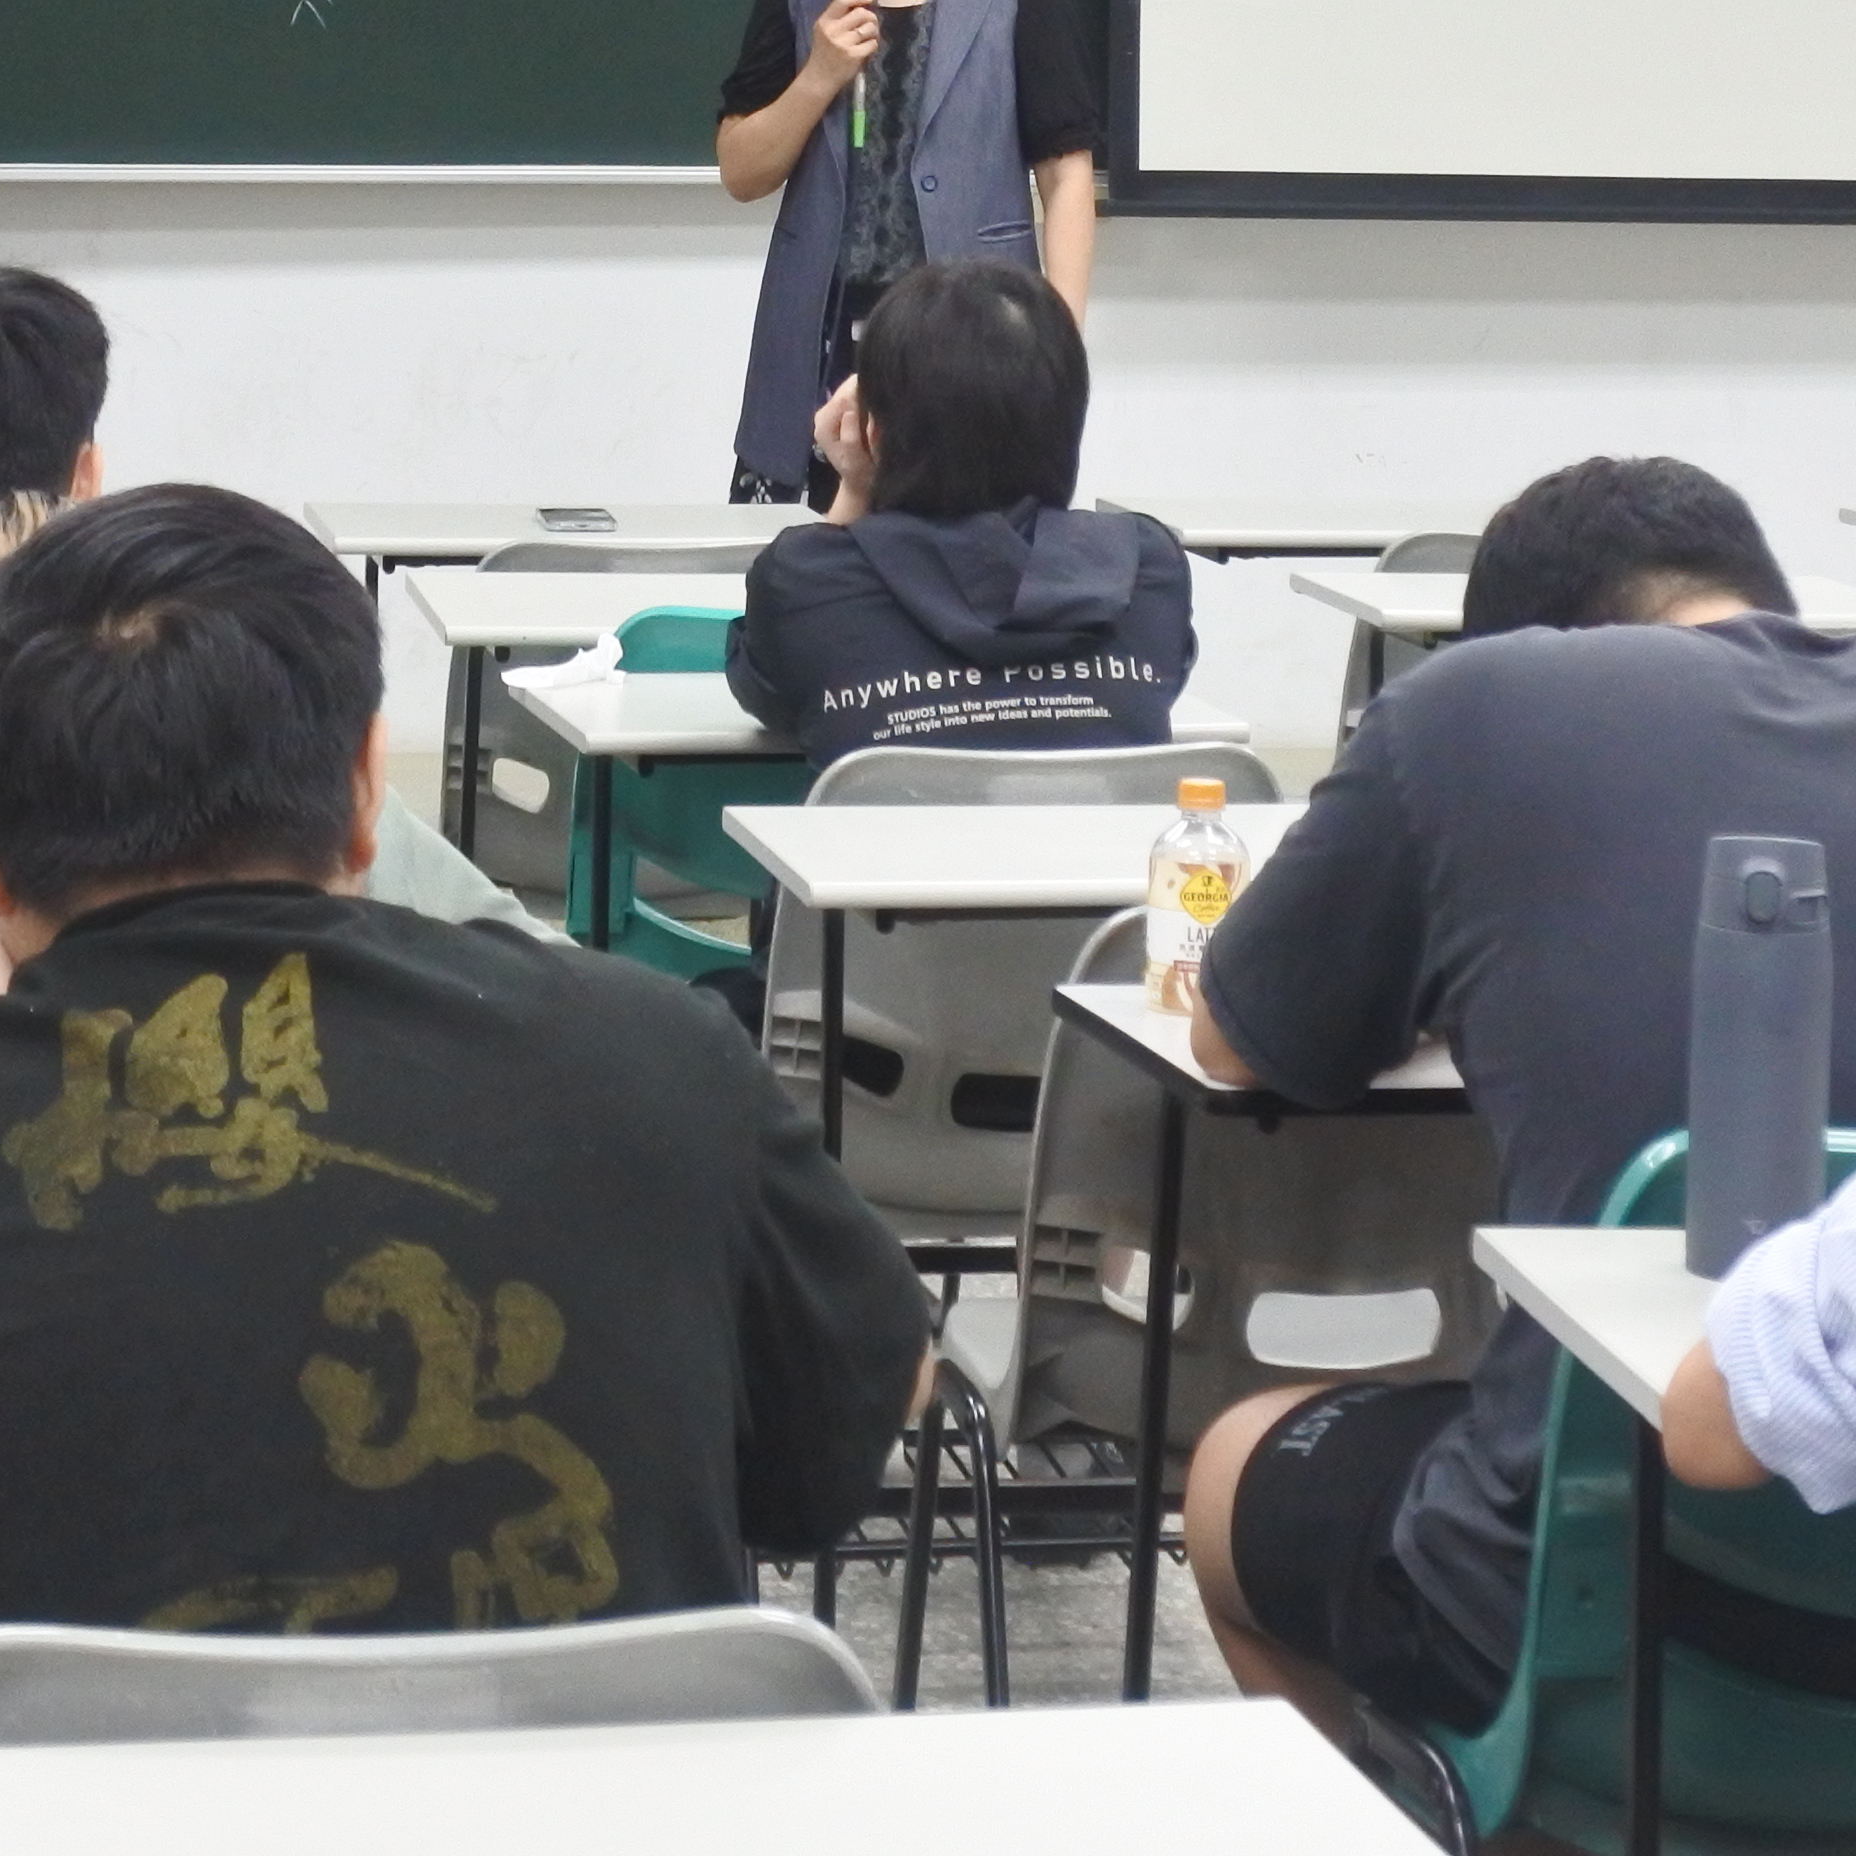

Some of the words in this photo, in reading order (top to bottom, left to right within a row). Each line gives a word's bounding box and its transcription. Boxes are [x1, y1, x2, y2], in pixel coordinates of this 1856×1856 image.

[822, 666, 983, 713] Anywhere
[872, 728, 892, 741] our
[894, 723, 913, 737] life
[914, 718, 942, 734] style
[944, 714, 968, 727] into
[971, 712, 996, 724] new
[1030, 707, 1052, 720] and
[1054, 706, 1113, 721] potentials.
[887, 705, 937, 726] STUDIOS
[939, 703, 960, 721] has
[962, 700, 983, 715] the
[985, 696, 1022, 711] power
[1024, 696, 1037, 707] to
[1039, 694, 1094, 708] transform
[1183, 891, 1230, 903] GEORGIA
[1187, 925, 1216, 943] LAT
